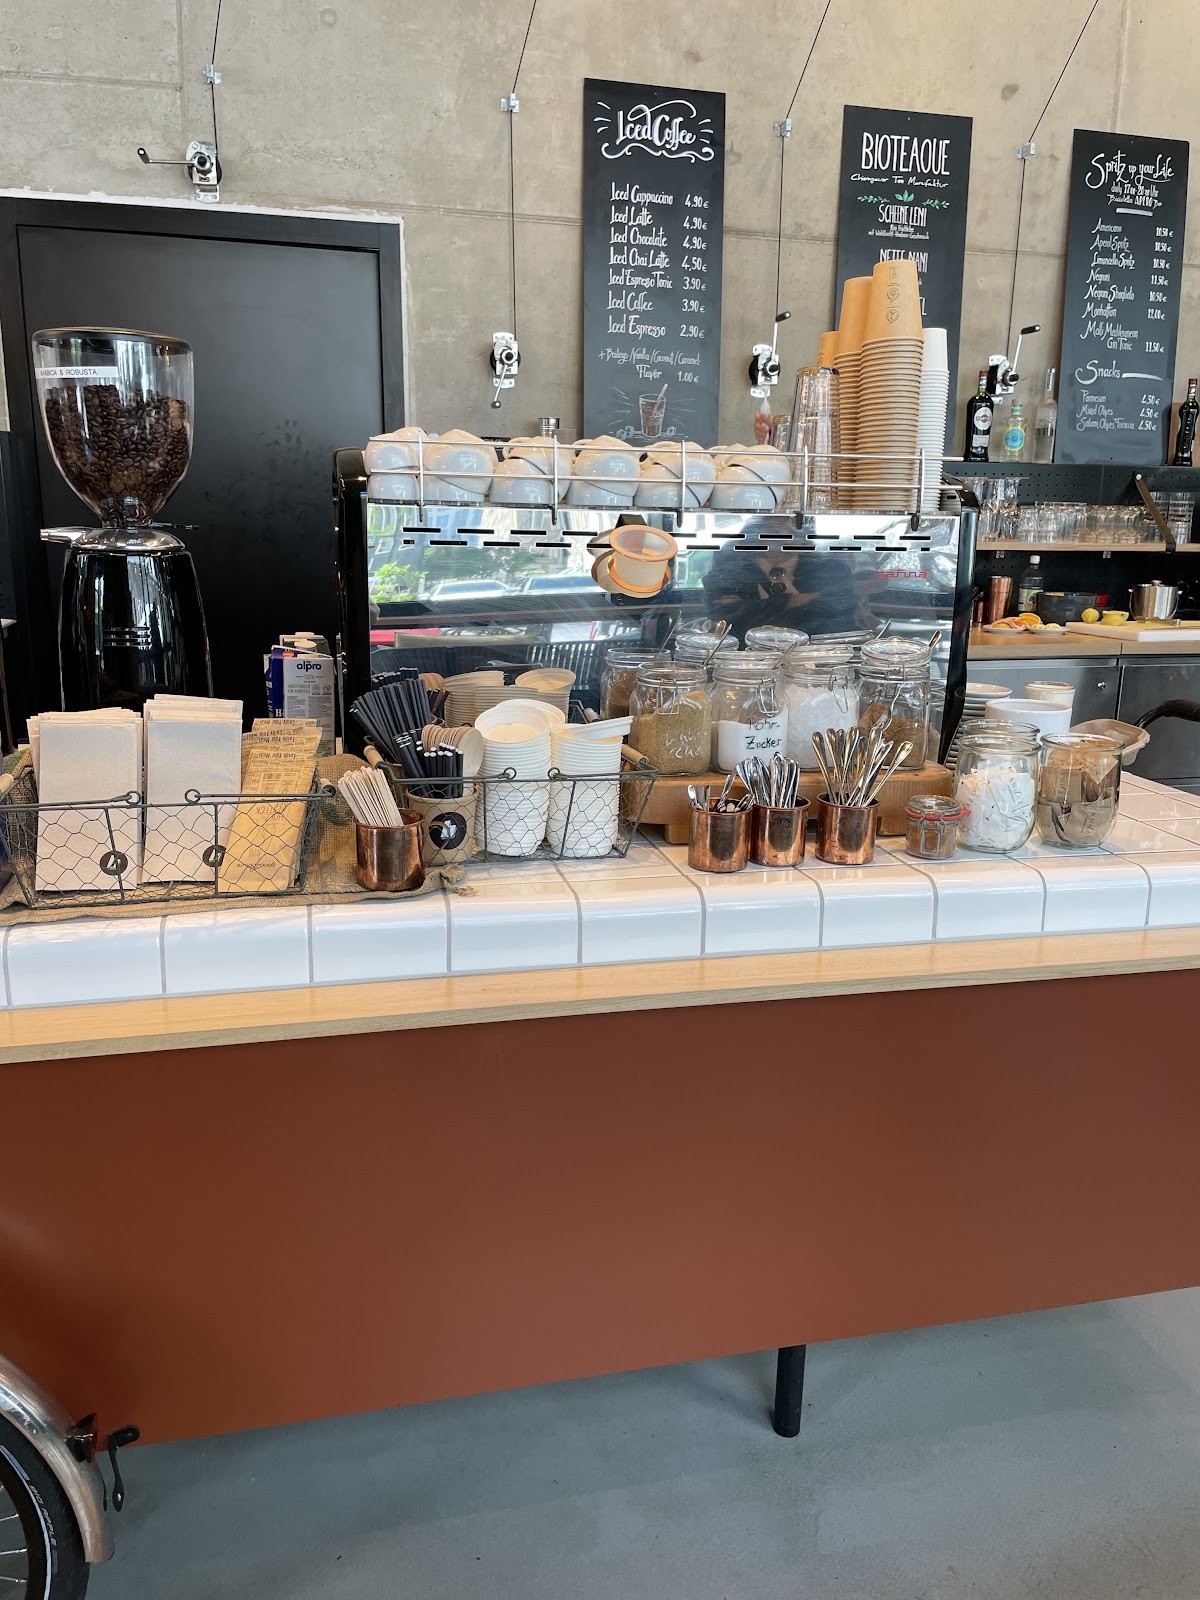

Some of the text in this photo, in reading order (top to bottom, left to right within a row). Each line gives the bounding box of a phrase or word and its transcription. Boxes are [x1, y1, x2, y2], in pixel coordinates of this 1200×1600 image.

[616, 104, 697, 151] Iced Coffee
[610, 182, 630, 201] Iced
[631, 185, 674, 207] Cappuccino
[610, 205, 629, 224] Iced
[628, 206, 653, 226] Latte
[609, 225, 628, 243] Iced
[630, 227, 668, 247] Chocolate
[609, 246, 628, 265] Iced
[629, 248, 648, 266] Chai
[648, 250, 670, 269] Latte
[608, 268, 625, 285] Iced
[607, 290, 626, 310] Iced
[627, 291, 654, 312] Coffee
[607, 313, 627, 333] Iced
[628, 315, 666, 340] Espresso
[66, 368, 98, 376] ROBUSTA
[1074, 359, 1121, 385] Snacks
[296, 660, 322, 672] alpro
[29, 1485, 57, 1546] BIG APPLE
